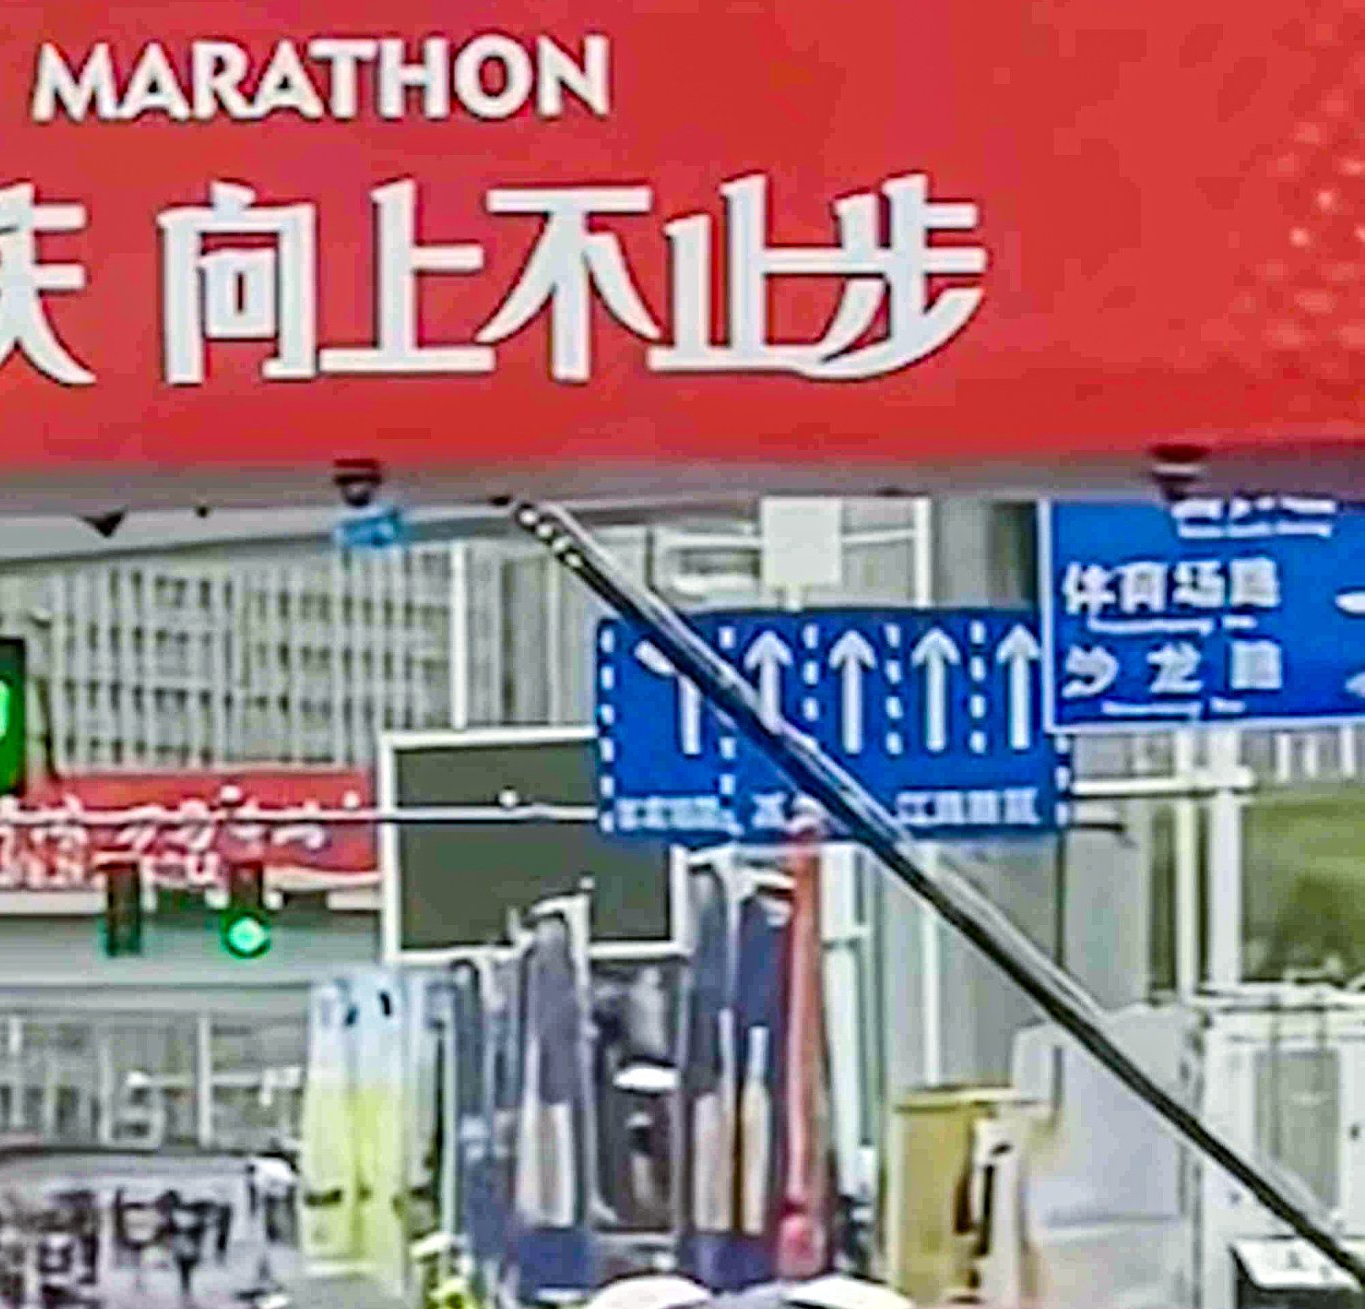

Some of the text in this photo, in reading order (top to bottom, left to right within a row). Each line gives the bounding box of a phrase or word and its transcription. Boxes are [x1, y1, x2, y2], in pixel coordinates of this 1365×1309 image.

[32, 36, 610, 121] MARATHON
[156, 174, 987, 385] 向上不止步
